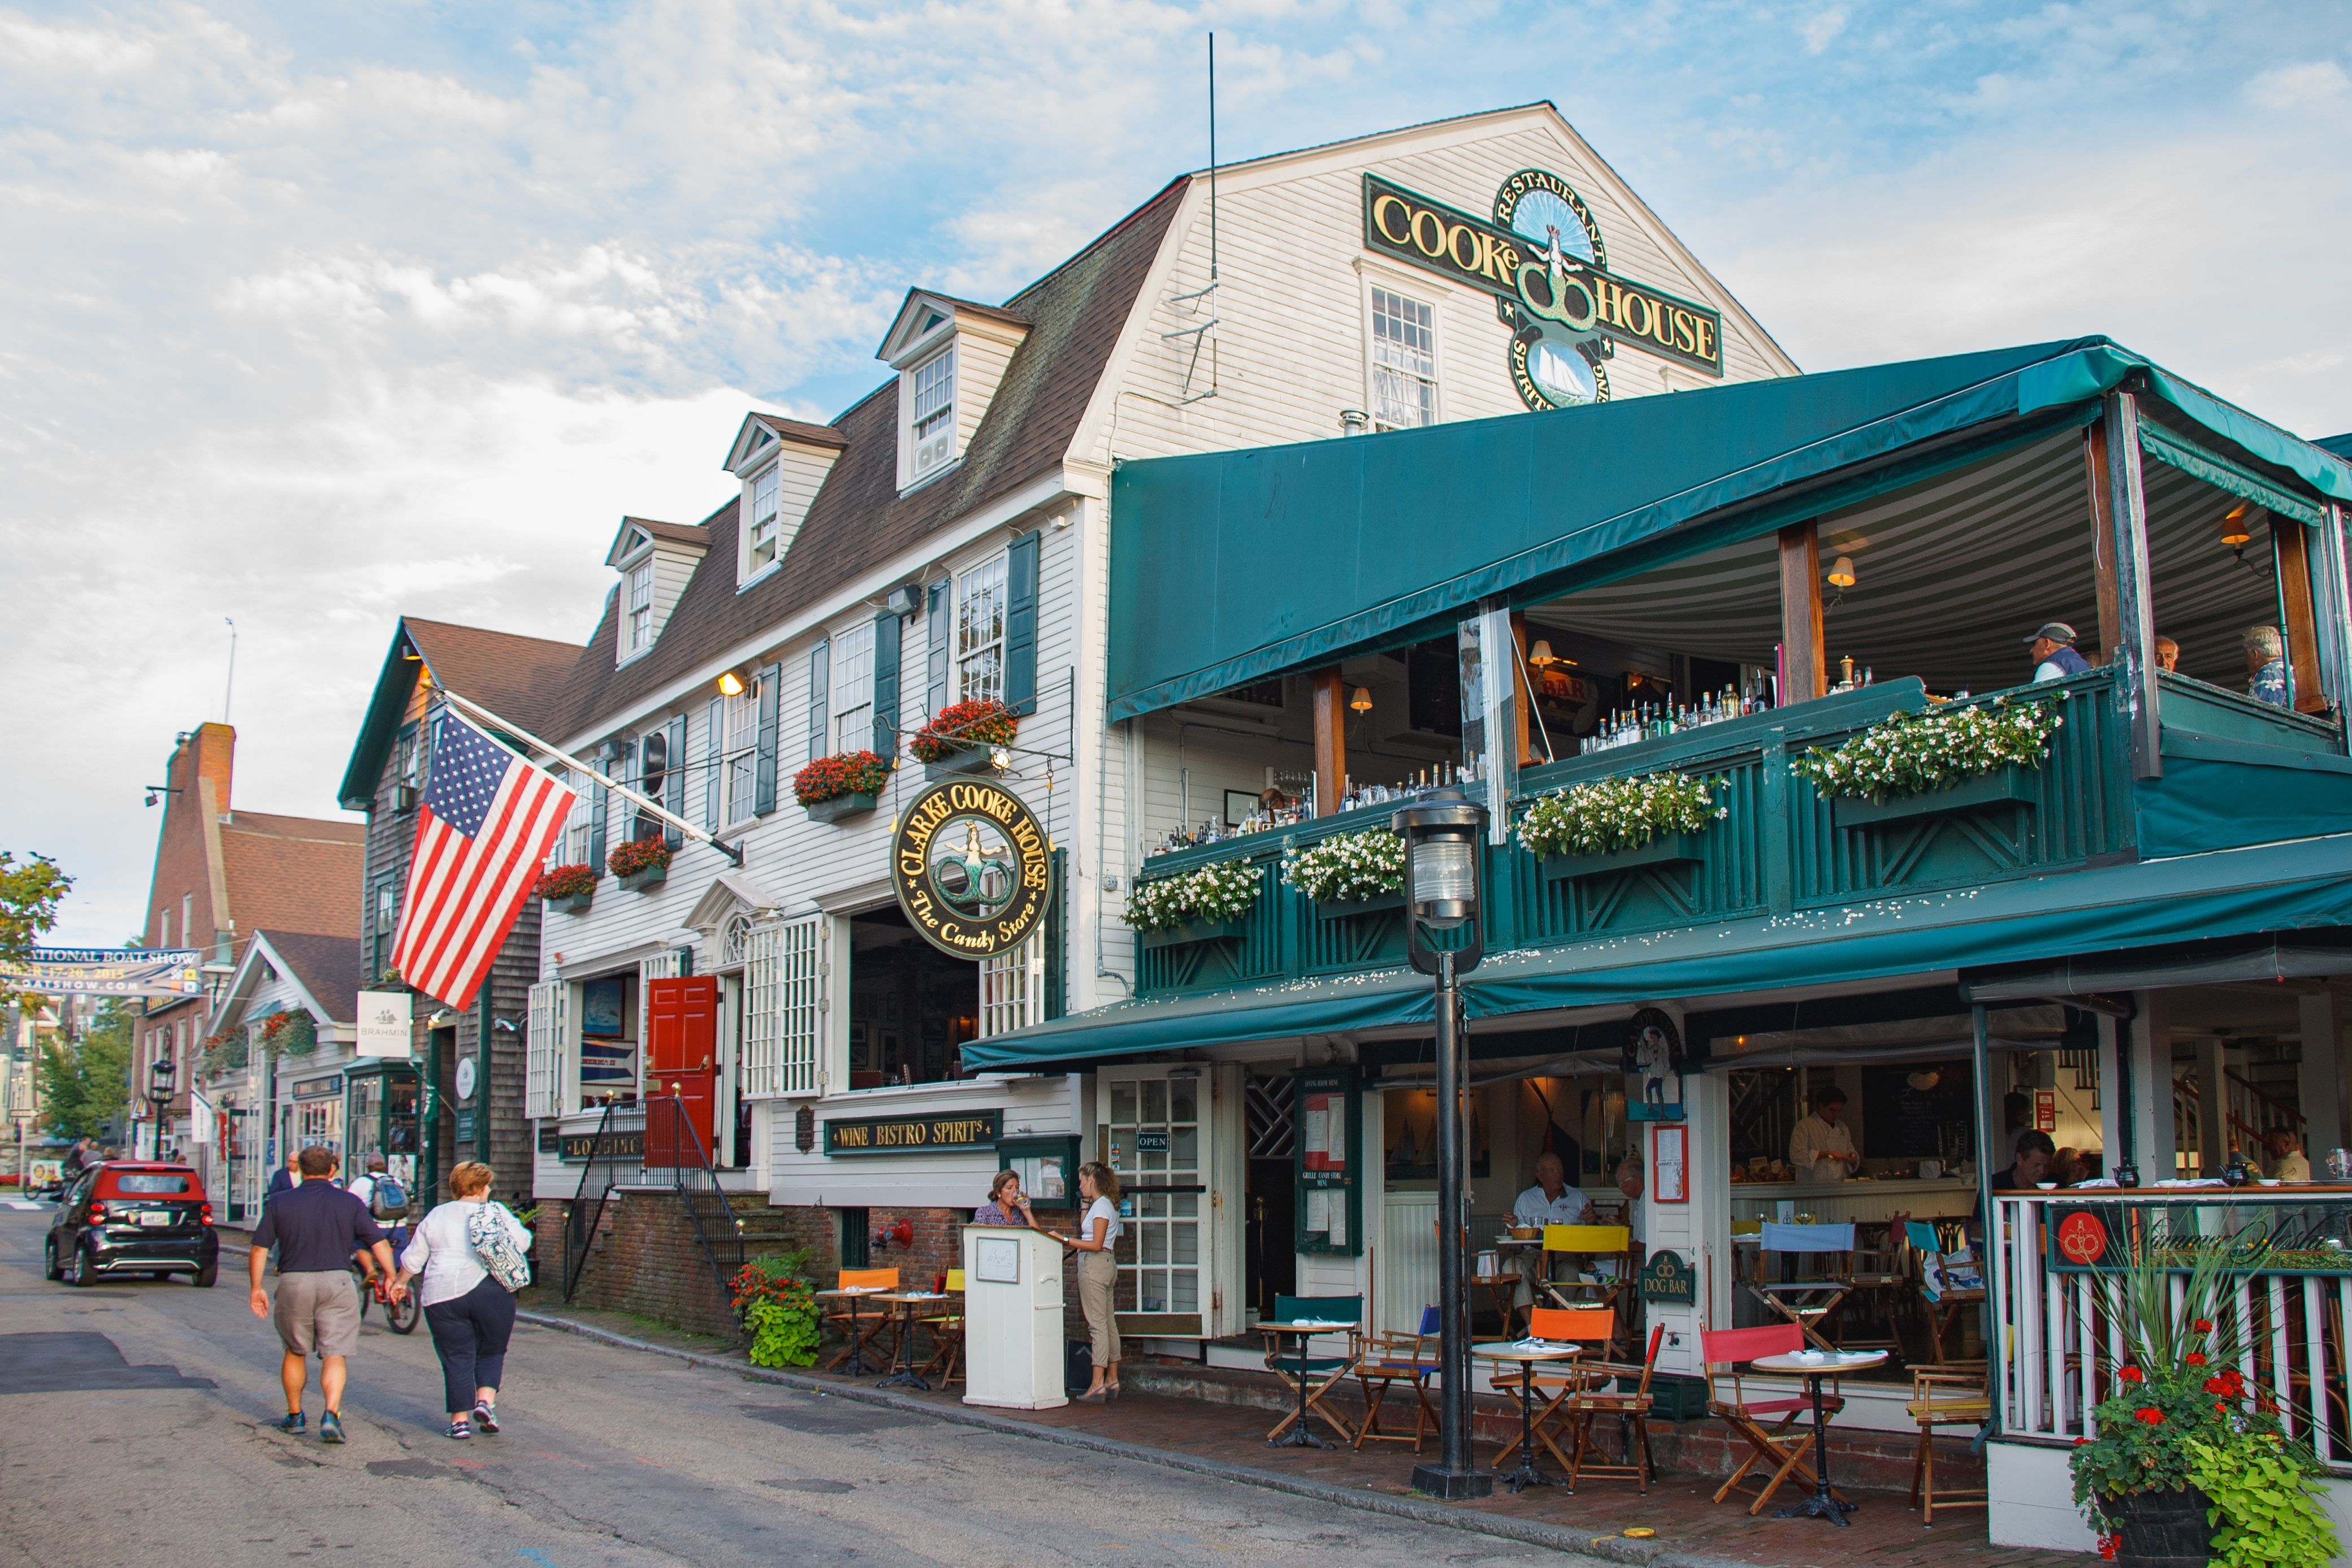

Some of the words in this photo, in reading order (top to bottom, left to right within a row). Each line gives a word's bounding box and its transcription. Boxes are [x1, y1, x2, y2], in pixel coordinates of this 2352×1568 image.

[1498, 172, 1605, 265] RESTAURANT
[1594, 277, 1717, 362] HOUSE
[1540, 679, 1586, 699] BAR
[901, 791, 952, 876] CLARKE
[950, 785, 1017, 825] COOKE
[1011, 816, 1046, 891] HOUSE
[911, 890, 939, 928] The
[941, 922, 995, 952] Candy
[998, 902, 1034, 942] Store
[23, 949, 100, 962] ATIONAL
[102, 951, 145, 963] BOAT
[147, 952, 196, 964] SHOW
[93, 968, 124, 979] 2015
[361, 1028, 407, 1037] BRAHMIN
[839, 1127, 868, 1146] WINE
[876, 1123, 926, 1145] BISTRO
[1140, 1137, 1166, 1146] OPEN
[1645, 1279, 1666, 1293] DOG
[1669, 1279, 1687, 1294] BAR
